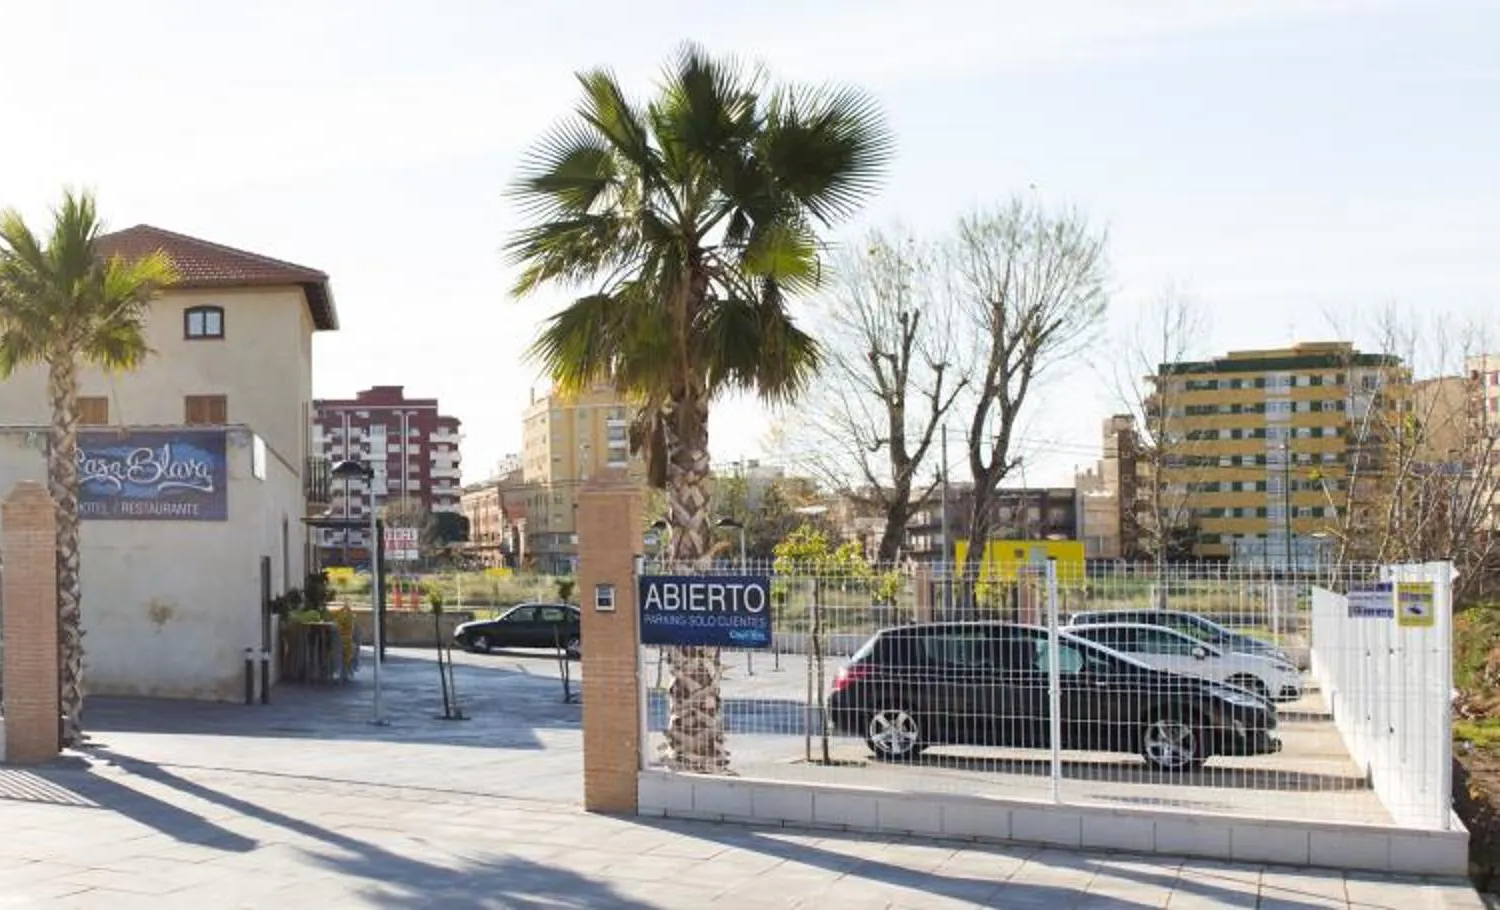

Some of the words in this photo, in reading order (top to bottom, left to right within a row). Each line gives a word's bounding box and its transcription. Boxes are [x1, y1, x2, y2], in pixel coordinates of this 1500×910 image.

[126, 443, 214, 492] Blava
[121, 501, 200, 516] RESTAURANTE
[644, 583, 765, 613] ABIERTO
[643, 613, 687, 626] PARKING
[718, 615, 766, 628] CLIENTES
